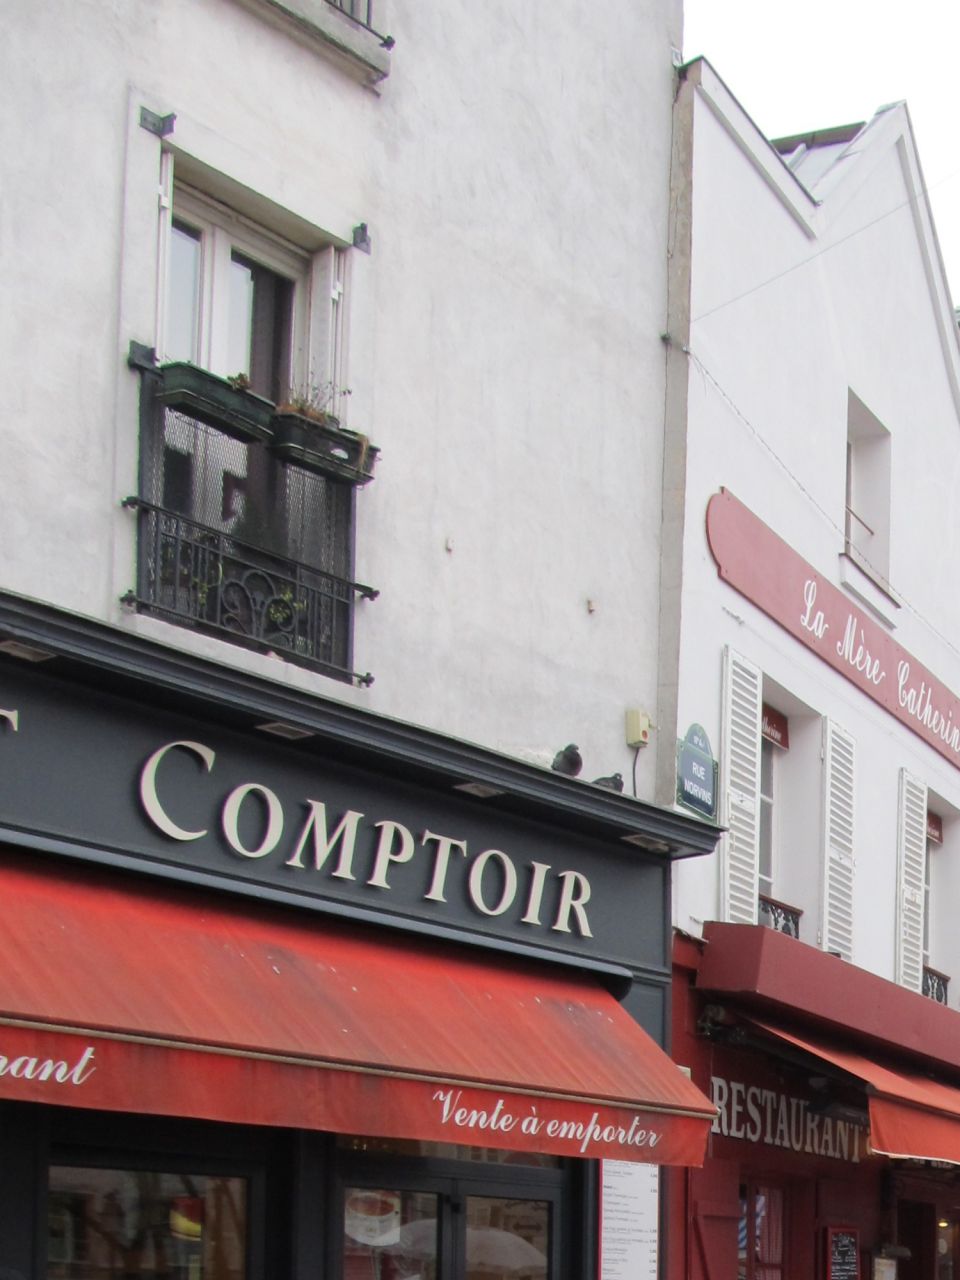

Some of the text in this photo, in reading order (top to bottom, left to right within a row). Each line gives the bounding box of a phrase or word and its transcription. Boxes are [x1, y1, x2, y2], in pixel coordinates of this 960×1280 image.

[801, 580, 829, 639] La
[837, 614, 885, 684] Mère
[684, 778, 712, 805] NORVINS
[692, 761, 706, 781] RUE
[433, 1090, 663, 1153] Vente à emporter
[710, 1075, 864, 1163] RESTAURANT
